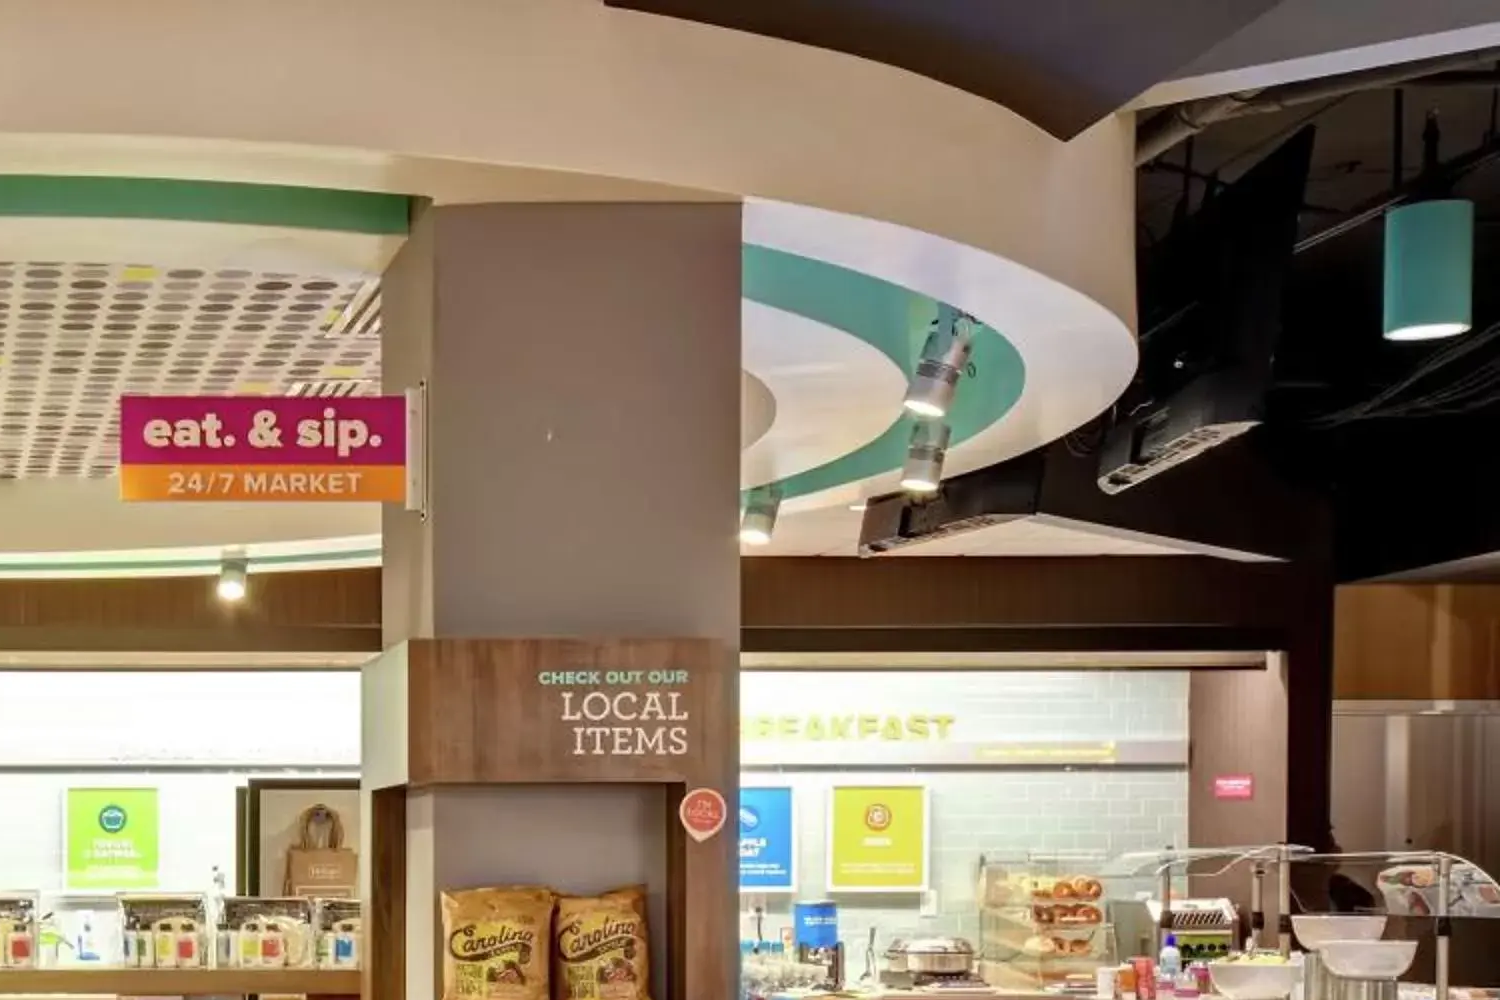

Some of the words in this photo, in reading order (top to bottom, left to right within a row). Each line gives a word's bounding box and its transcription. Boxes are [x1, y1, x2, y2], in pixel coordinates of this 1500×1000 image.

[143, 413, 236, 447] eat.
[248, 410, 284, 448] &
[296, 408, 382, 457] sip.
[168, 473, 233, 494] 24/7
[244, 473, 362, 493] MARKET
[538, 671, 600, 685] CHECK
[605, 671, 642, 685] OUT
[648, 670, 689, 684] OUR
[561, 692, 689, 721] LOCAL
[573, 727, 689, 755] ITEMS
[743, 713, 956, 742] REAKFAST
